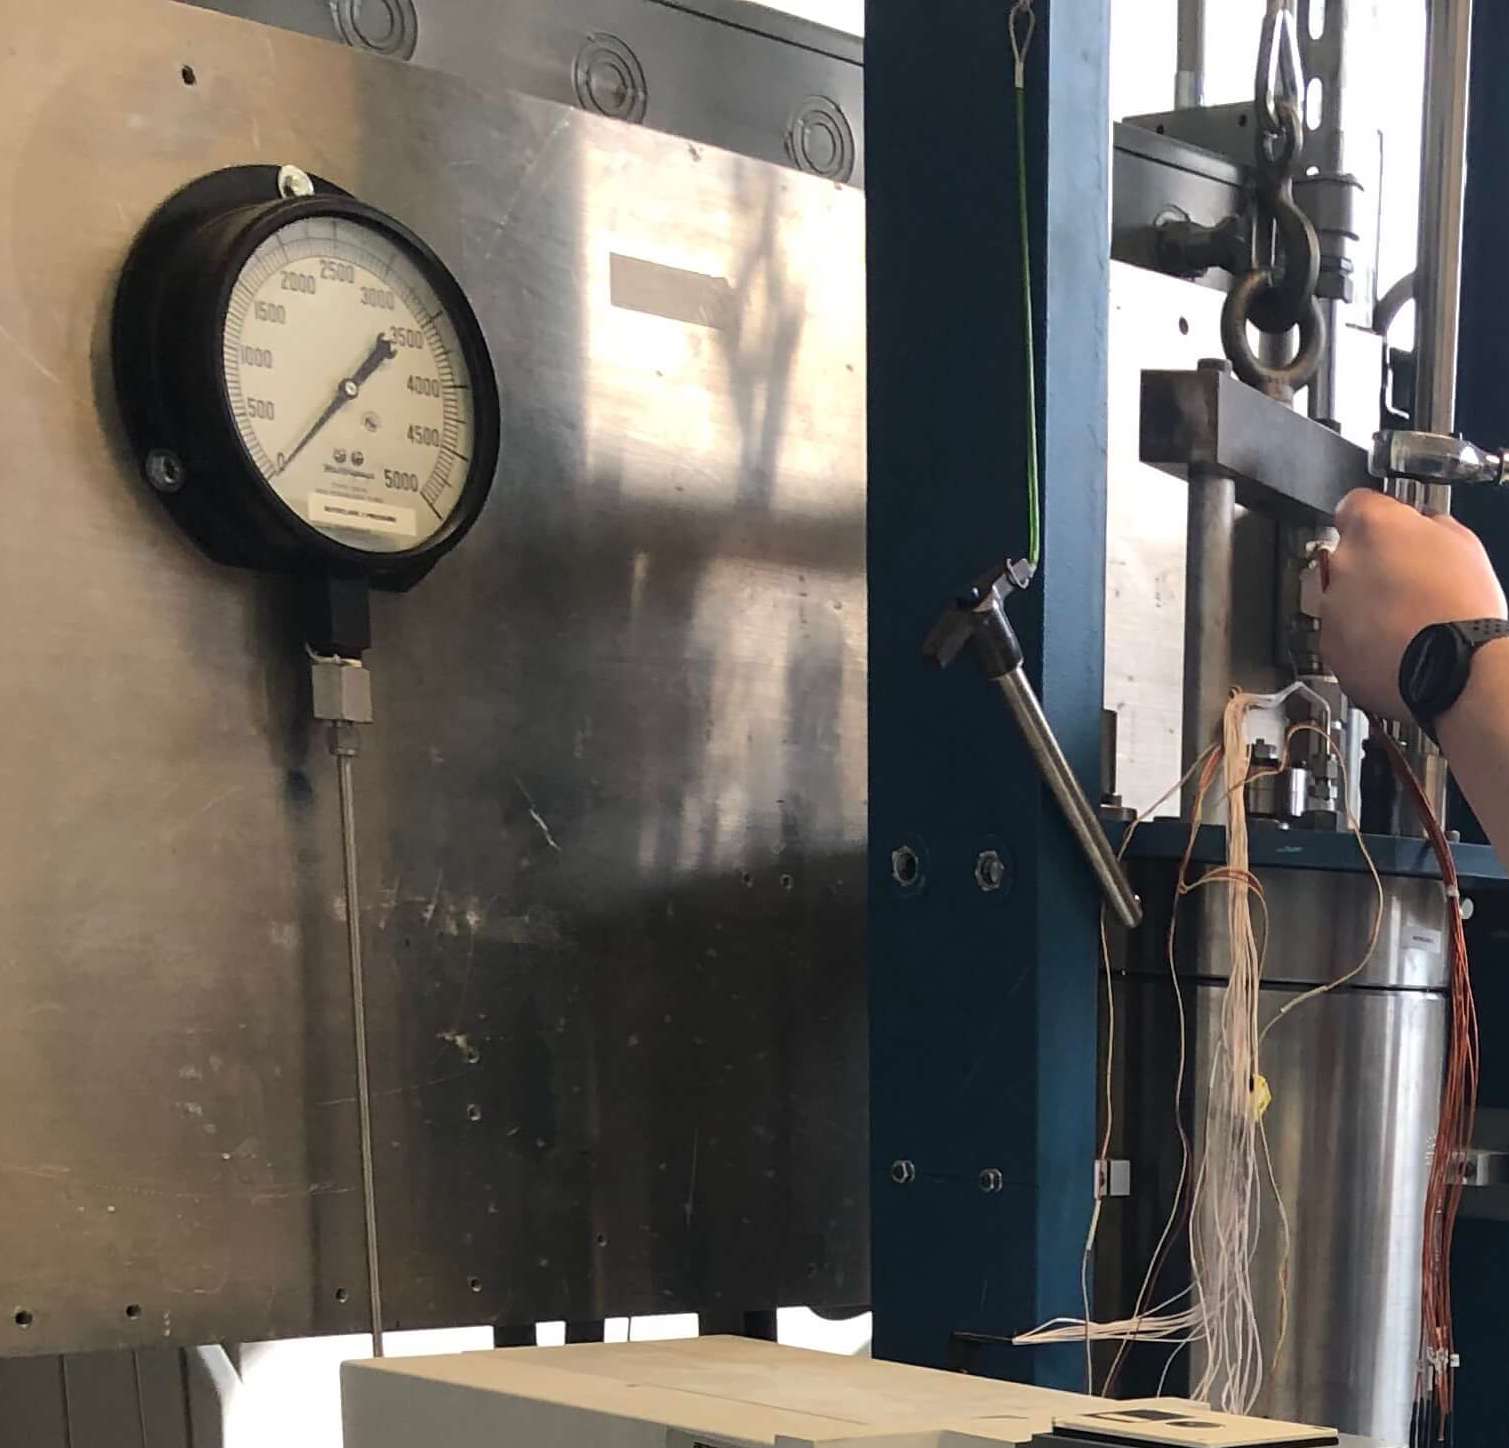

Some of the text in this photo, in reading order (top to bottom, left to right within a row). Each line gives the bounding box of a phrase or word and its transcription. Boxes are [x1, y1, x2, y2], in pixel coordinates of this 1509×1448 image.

[281, 271, 316, 295] 2000
[320, 260, 354, 284] 2500
[360, 287, 395, 310] 3000
[254, 301, 286, 324] 1500
[390, 326, 423, 349] 3500
[240, 345, 272, 369] 1000
[407, 375, 440, 398] 4000
[247, 398, 275, 420] 500
[407, 425, 440, 447] 4500
[277, 452, 286, 471] 0
[384, 468, 419, 493] 5000
